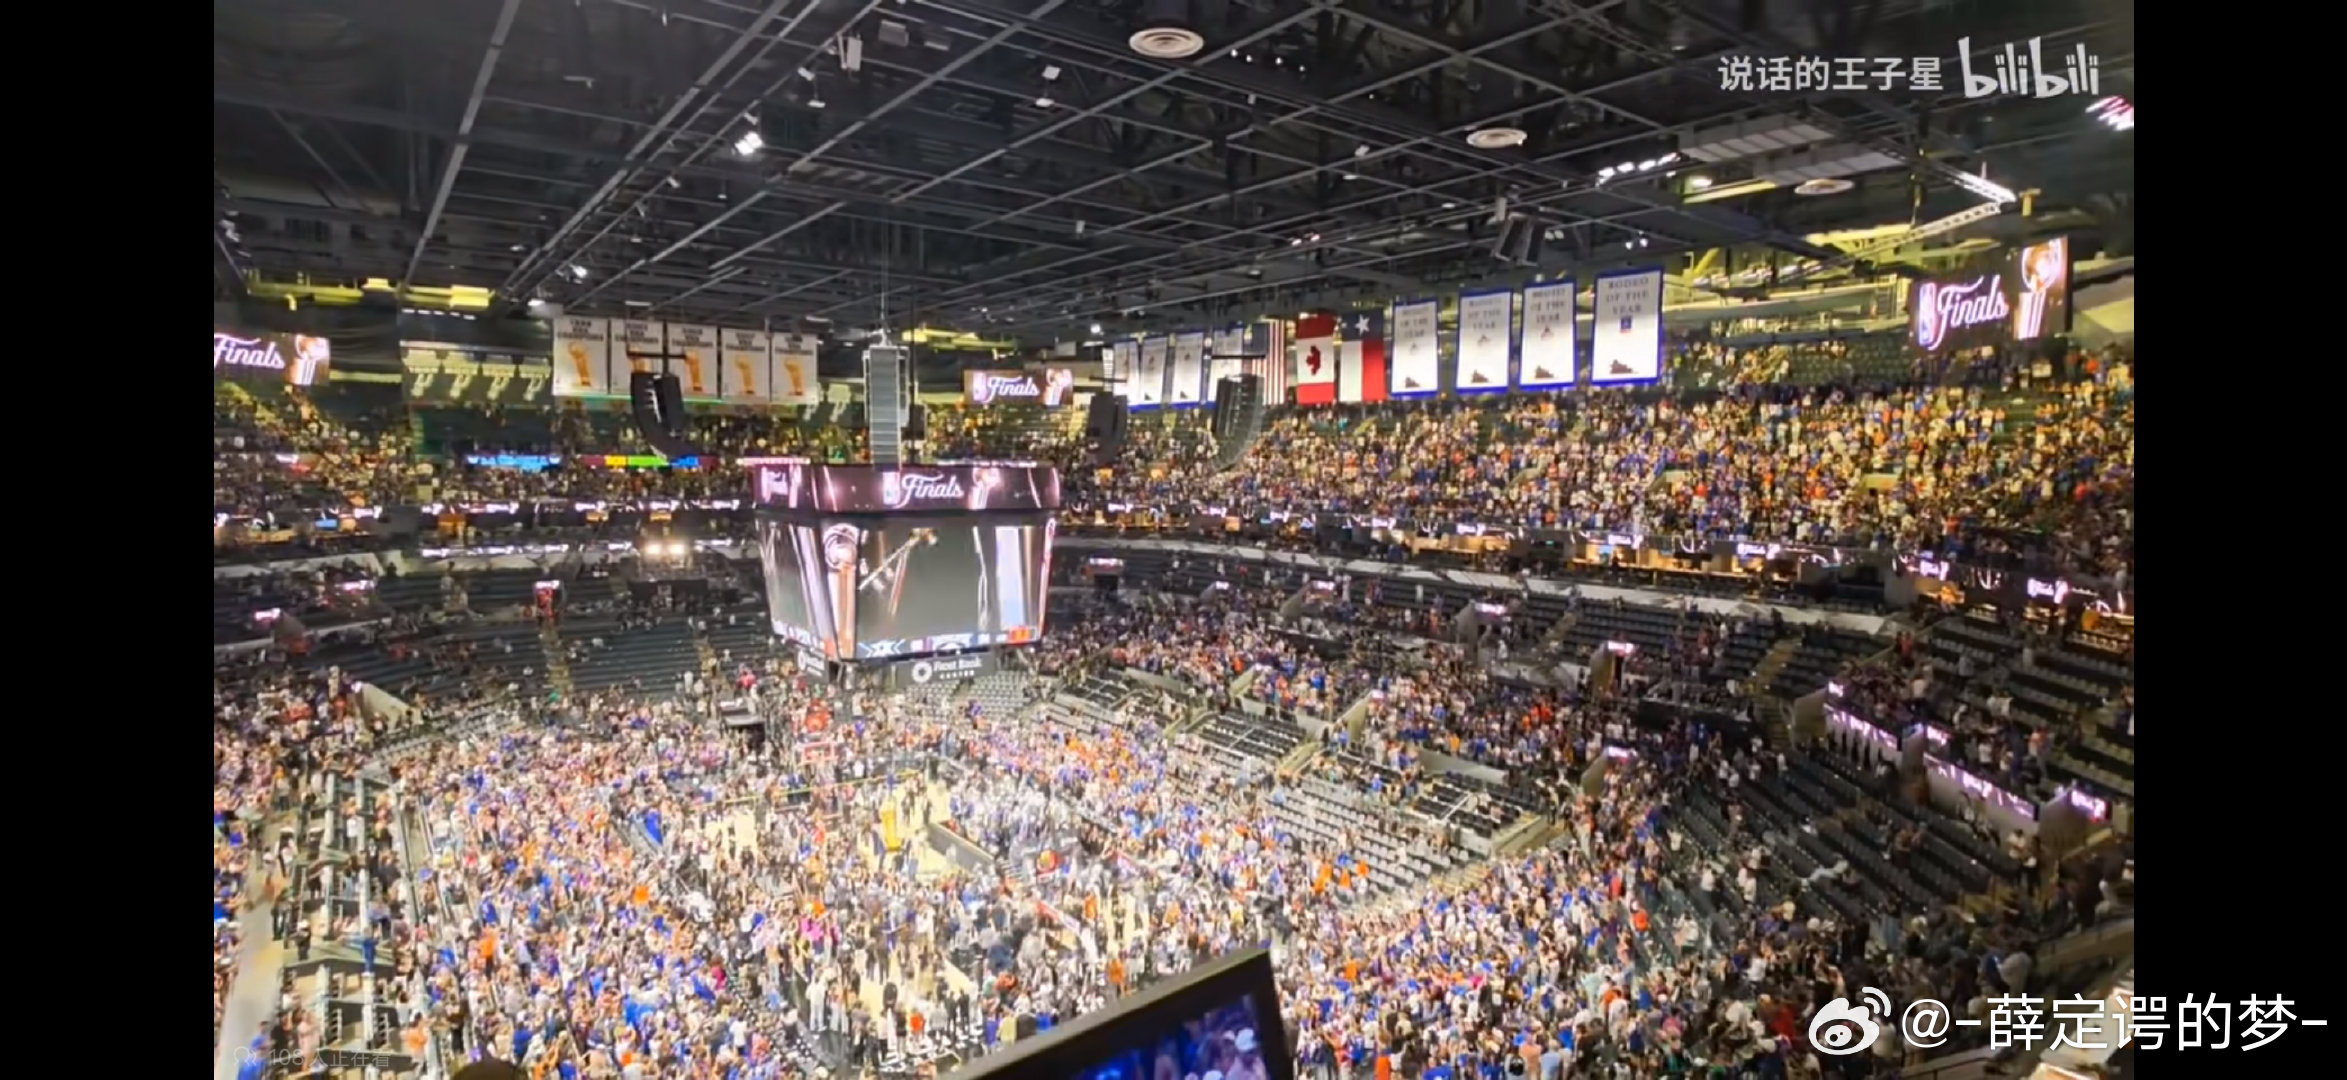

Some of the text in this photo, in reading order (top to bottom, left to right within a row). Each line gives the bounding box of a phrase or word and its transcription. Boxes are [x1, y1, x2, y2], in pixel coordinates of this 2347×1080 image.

[1928, 274, 2009, 350] Finals
[214, 332, 286, 369] Finals
[984, 375, 1040, 403] Finals
[893, 474, 964, 509] Finals
